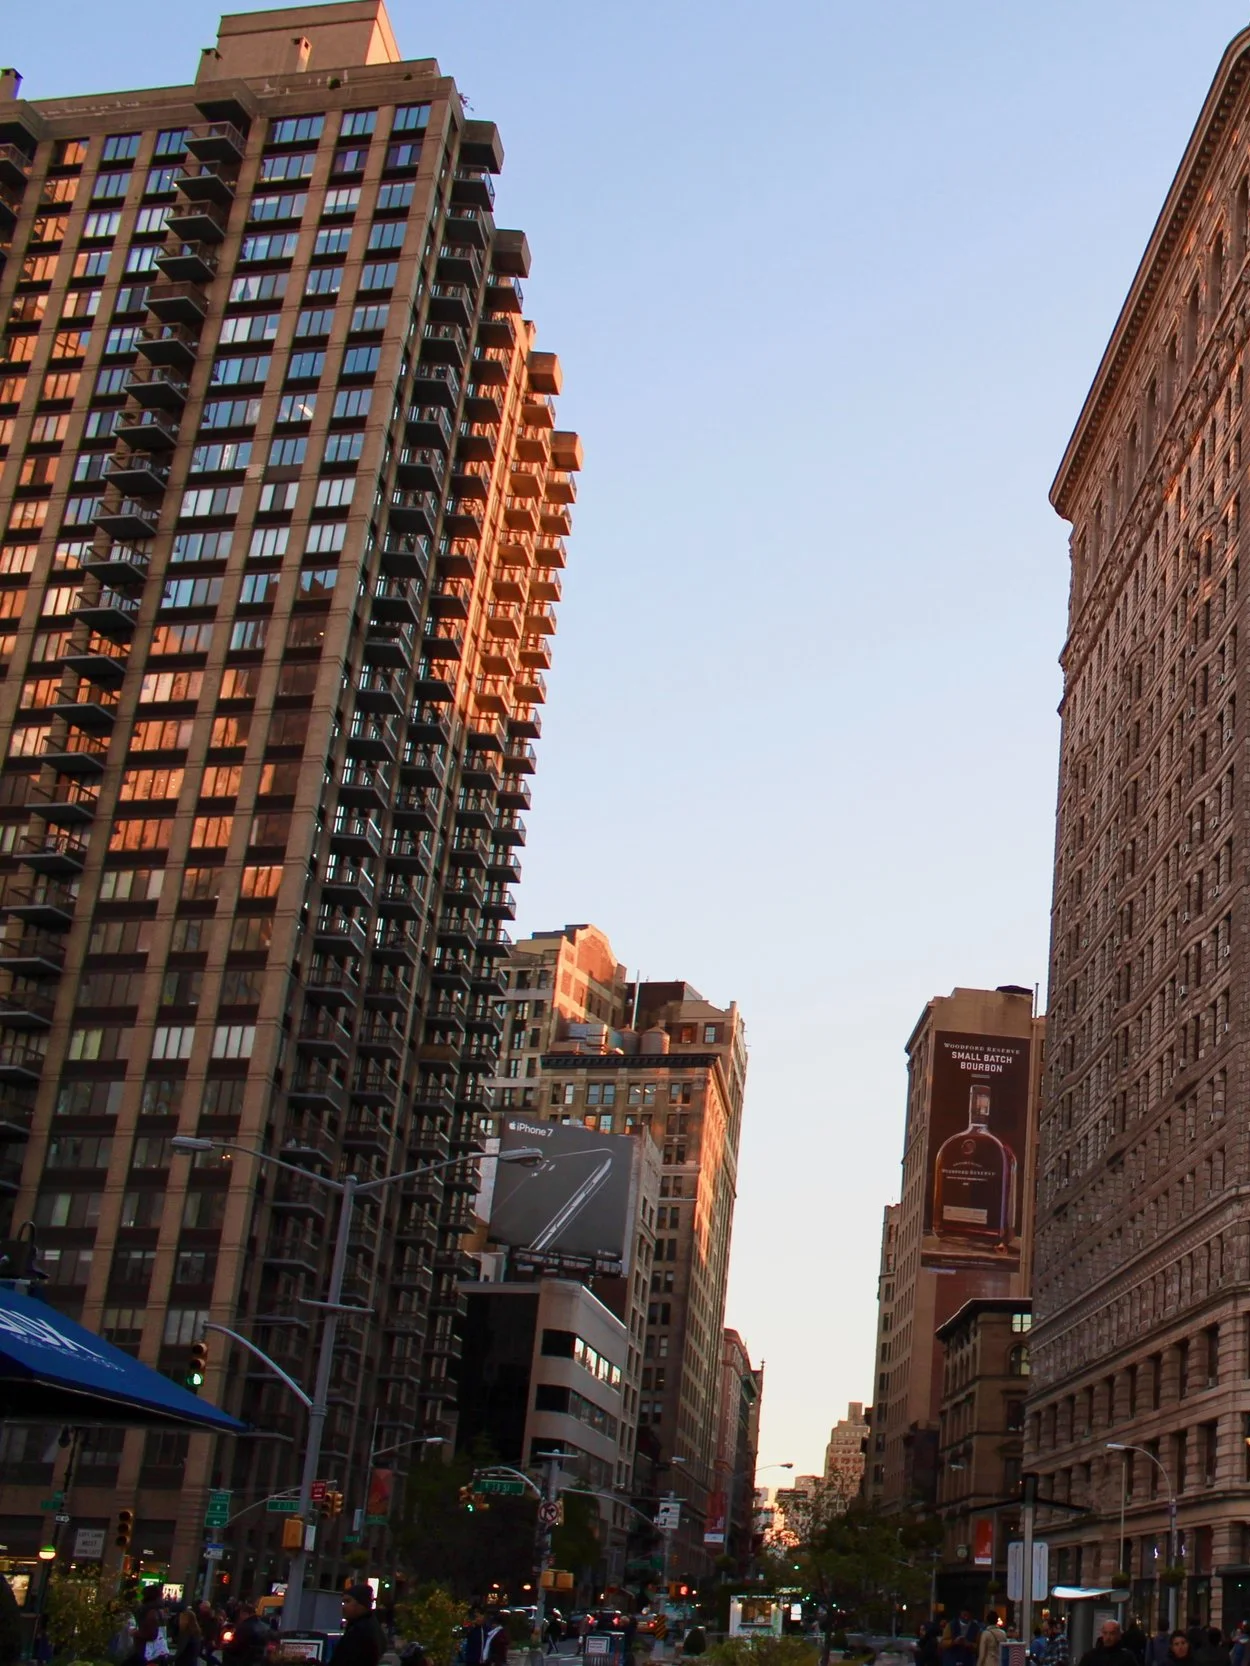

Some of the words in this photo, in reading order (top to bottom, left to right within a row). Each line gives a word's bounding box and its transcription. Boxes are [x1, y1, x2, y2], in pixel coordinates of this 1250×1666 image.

[944, 1042, 984, 1052] WOODFORD
[986, 1046, 1020, 1055] RESERVE
[951, 1051, 981, 1061] SMALL
[983, 1054, 1013, 1064] BATCH
[960, 1061, 1003, 1073] BOURBON
[516, 1122, 547, 1137] iPhone
[547, 1128, 554, 1138] 7
